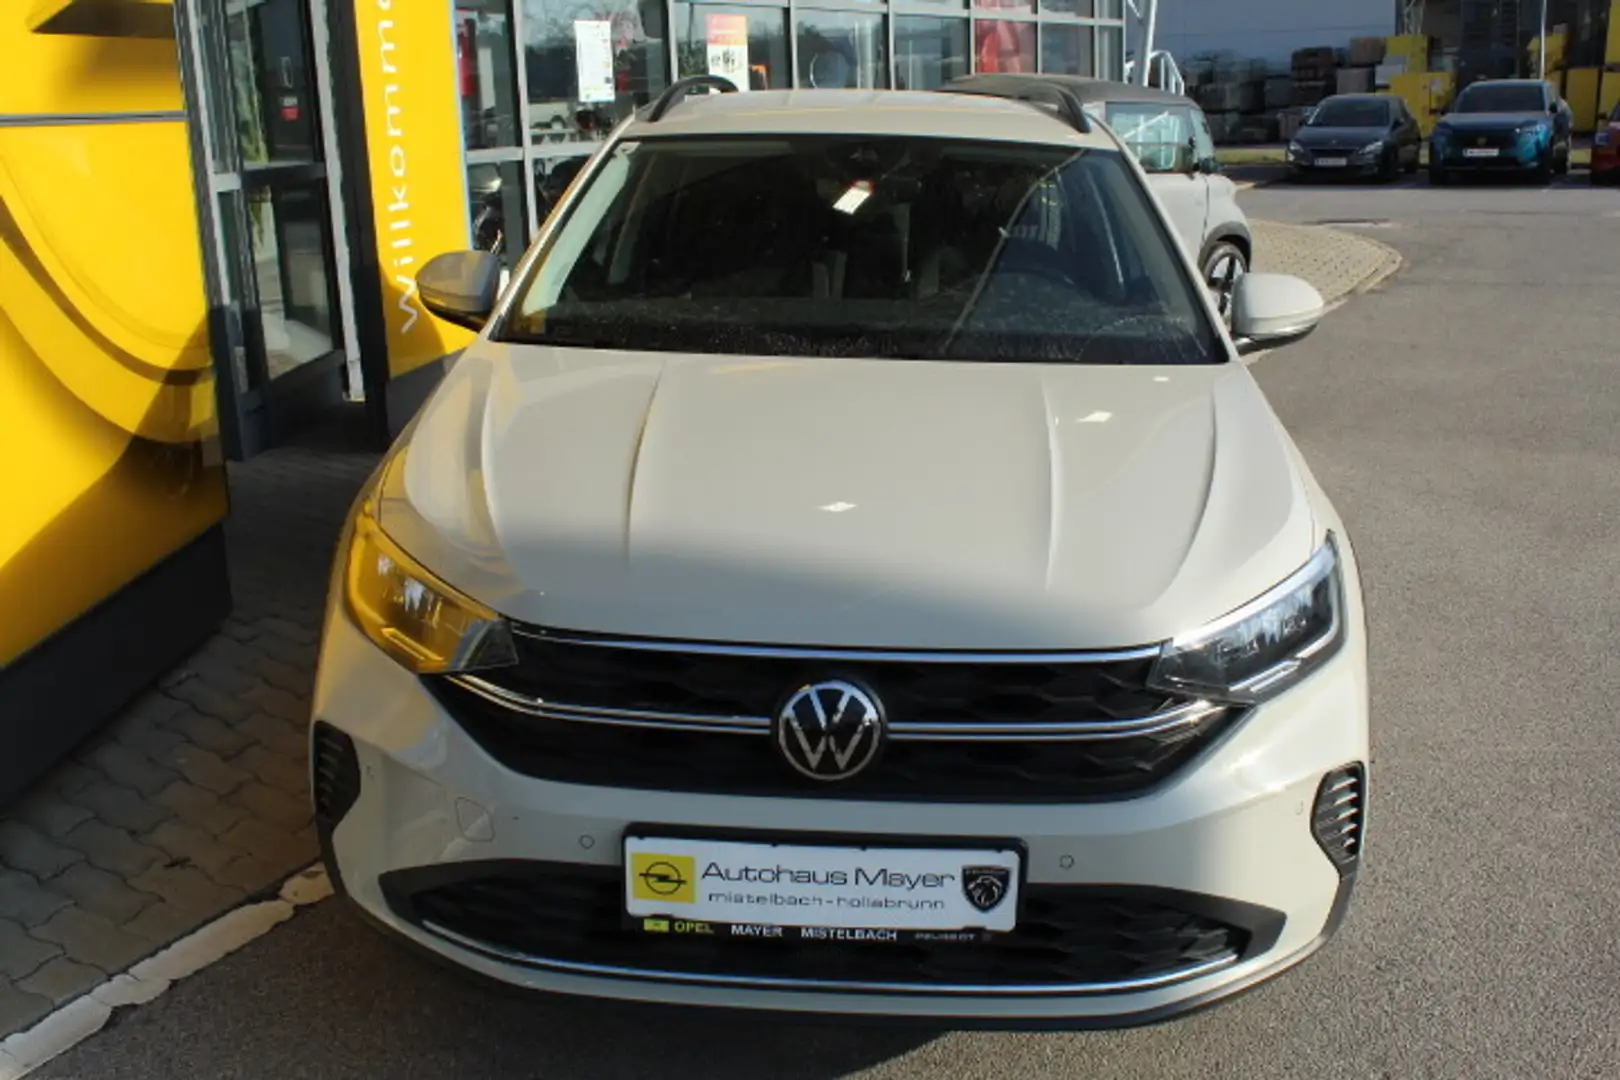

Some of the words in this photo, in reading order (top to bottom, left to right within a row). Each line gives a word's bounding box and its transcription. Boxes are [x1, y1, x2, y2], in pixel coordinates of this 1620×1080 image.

[701, 862, 847, 886] Autohaus
[854, 867, 956, 892] Mayer
[674, 921, 714, 933] OPEL
[730, 925, 782, 937] MAYER
[800, 927, 898, 941] MISTELBACH
